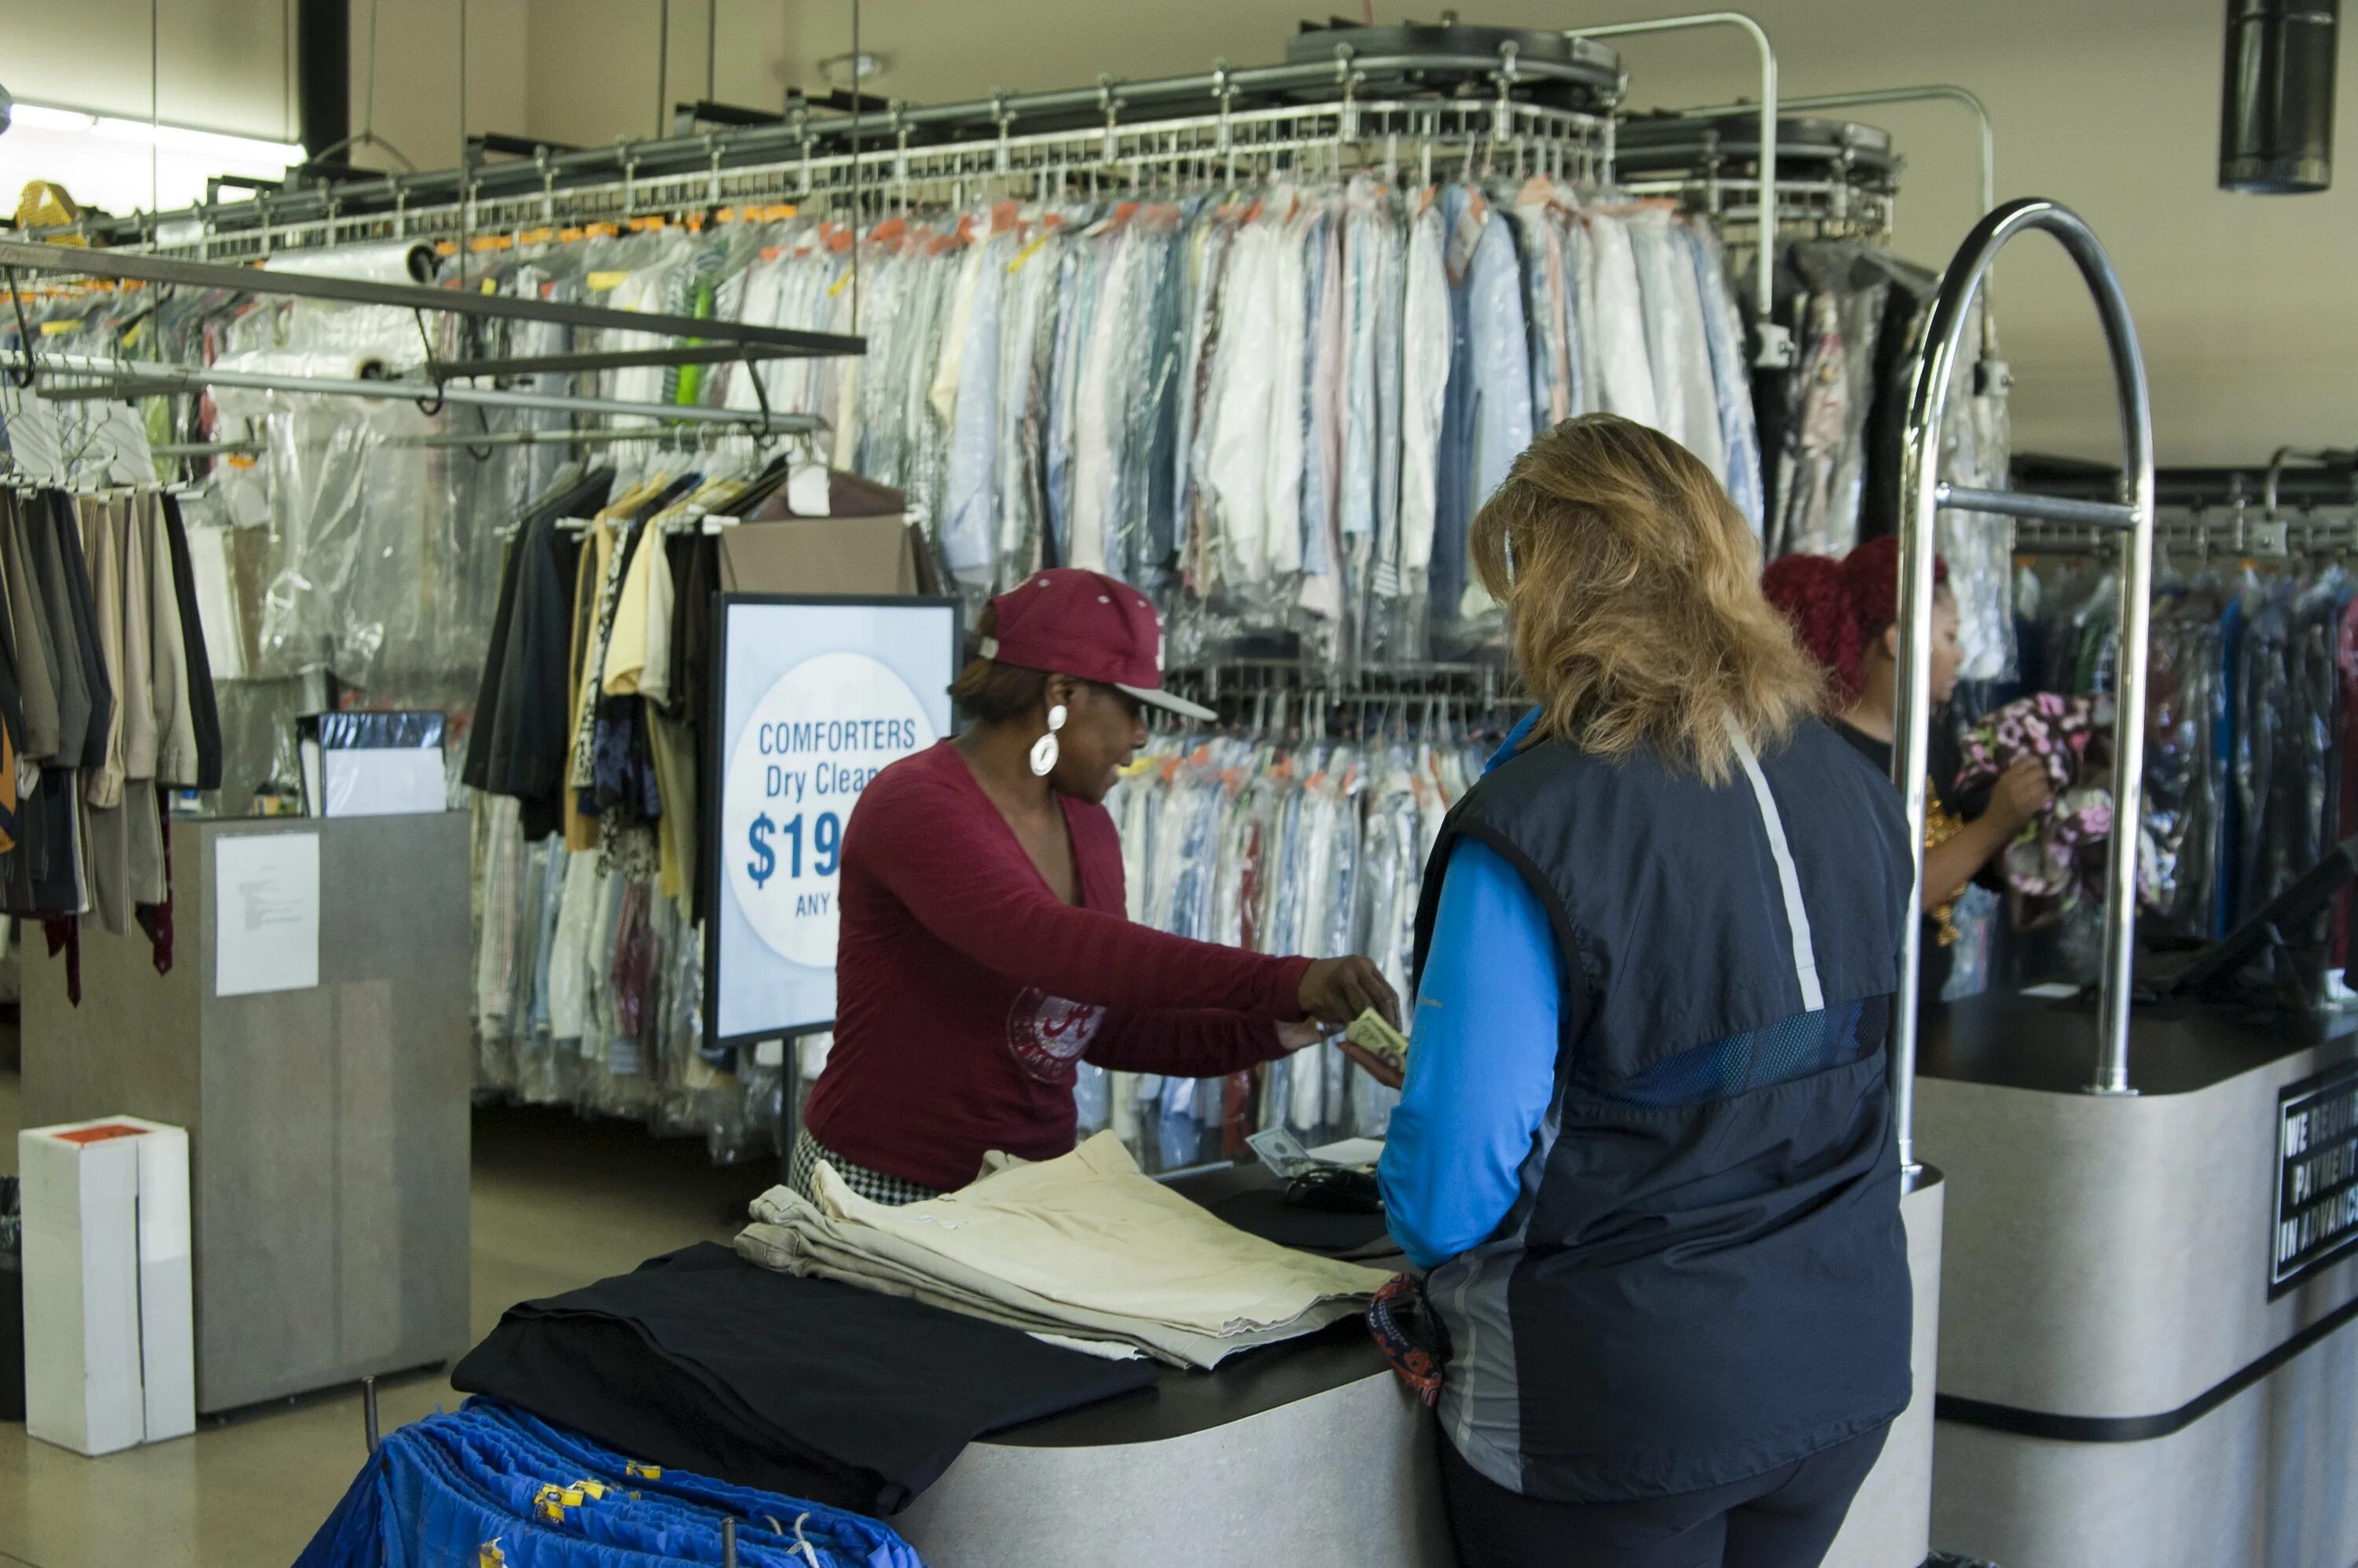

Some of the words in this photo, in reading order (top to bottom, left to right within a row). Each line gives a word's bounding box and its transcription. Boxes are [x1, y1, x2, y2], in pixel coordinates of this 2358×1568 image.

[759, 718, 916, 755] COMFORTERS
[766, 765, 807, 804] Dry
[747, 811, 840, 890] $19
[795, 893, 830, 917] ANY
